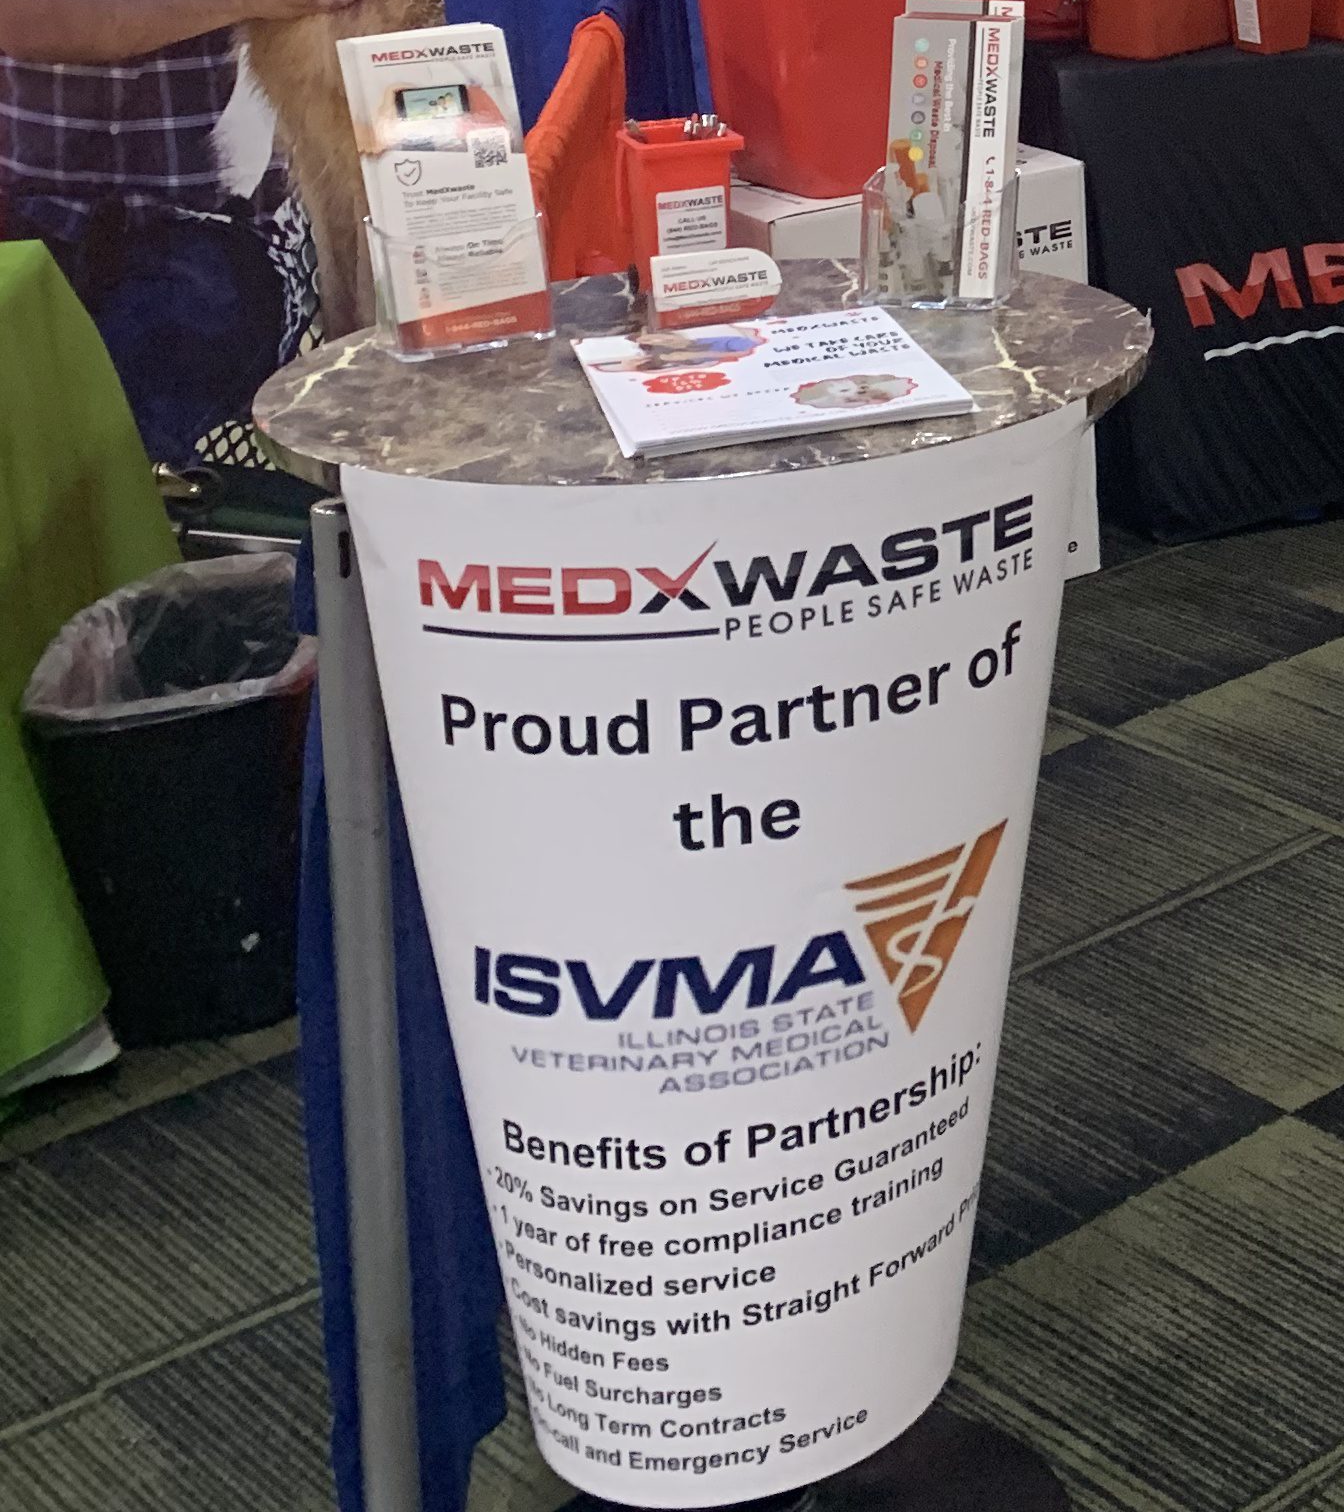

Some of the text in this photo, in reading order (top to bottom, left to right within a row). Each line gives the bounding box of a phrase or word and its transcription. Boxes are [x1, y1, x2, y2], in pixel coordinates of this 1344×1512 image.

[371, 42, 495, 64] MEDXWASTE
[982, 28, 1001, 138] MEDXWASTE
[1030, 239, 1073, 258] WASTE
[664, 270, 768, 294] MEDXWASTE
[418, 494, 1034, 617] MEDXWASTE
[725, 548, 1034, 641] PEOPLE SAFE WASTE
[441, 621, 1023, 756] Proud Partner of
[673, 793, 802, 852] the
[474, 929, 867, 1022] ISVMA
[510, 1016, 884, 1073] VETERINARY MEDICAL
[618, 990, 875, 1051] ILLINOIS STATE
[658, 1031, 890, 1096] ASSOCIATION
[503, 1042, 982, 1171] Benefits of Partnership:
[540, 1095, 970, 1223] Savings on Service Guaranteed
[565, 1232, 590, 1253] of
[599, 1233, 654, 1257] free
[664, 1206, 842, 1257] compliance
[851, 1156, 944, 1218] training
[554, 1213, 955, 1342] savings with Straight Forward
[663, 1264, 776, 1297] service
[540, 1330, 670, 1372] Hidden Fees
[543, 1361, 723, 1409] Fuel Surcharges
[585, 1408, 868, 1475] and Emergency Service
[594, 1412, 651, 1438] Term
[660, 1407, 787, 1439] Contracts
